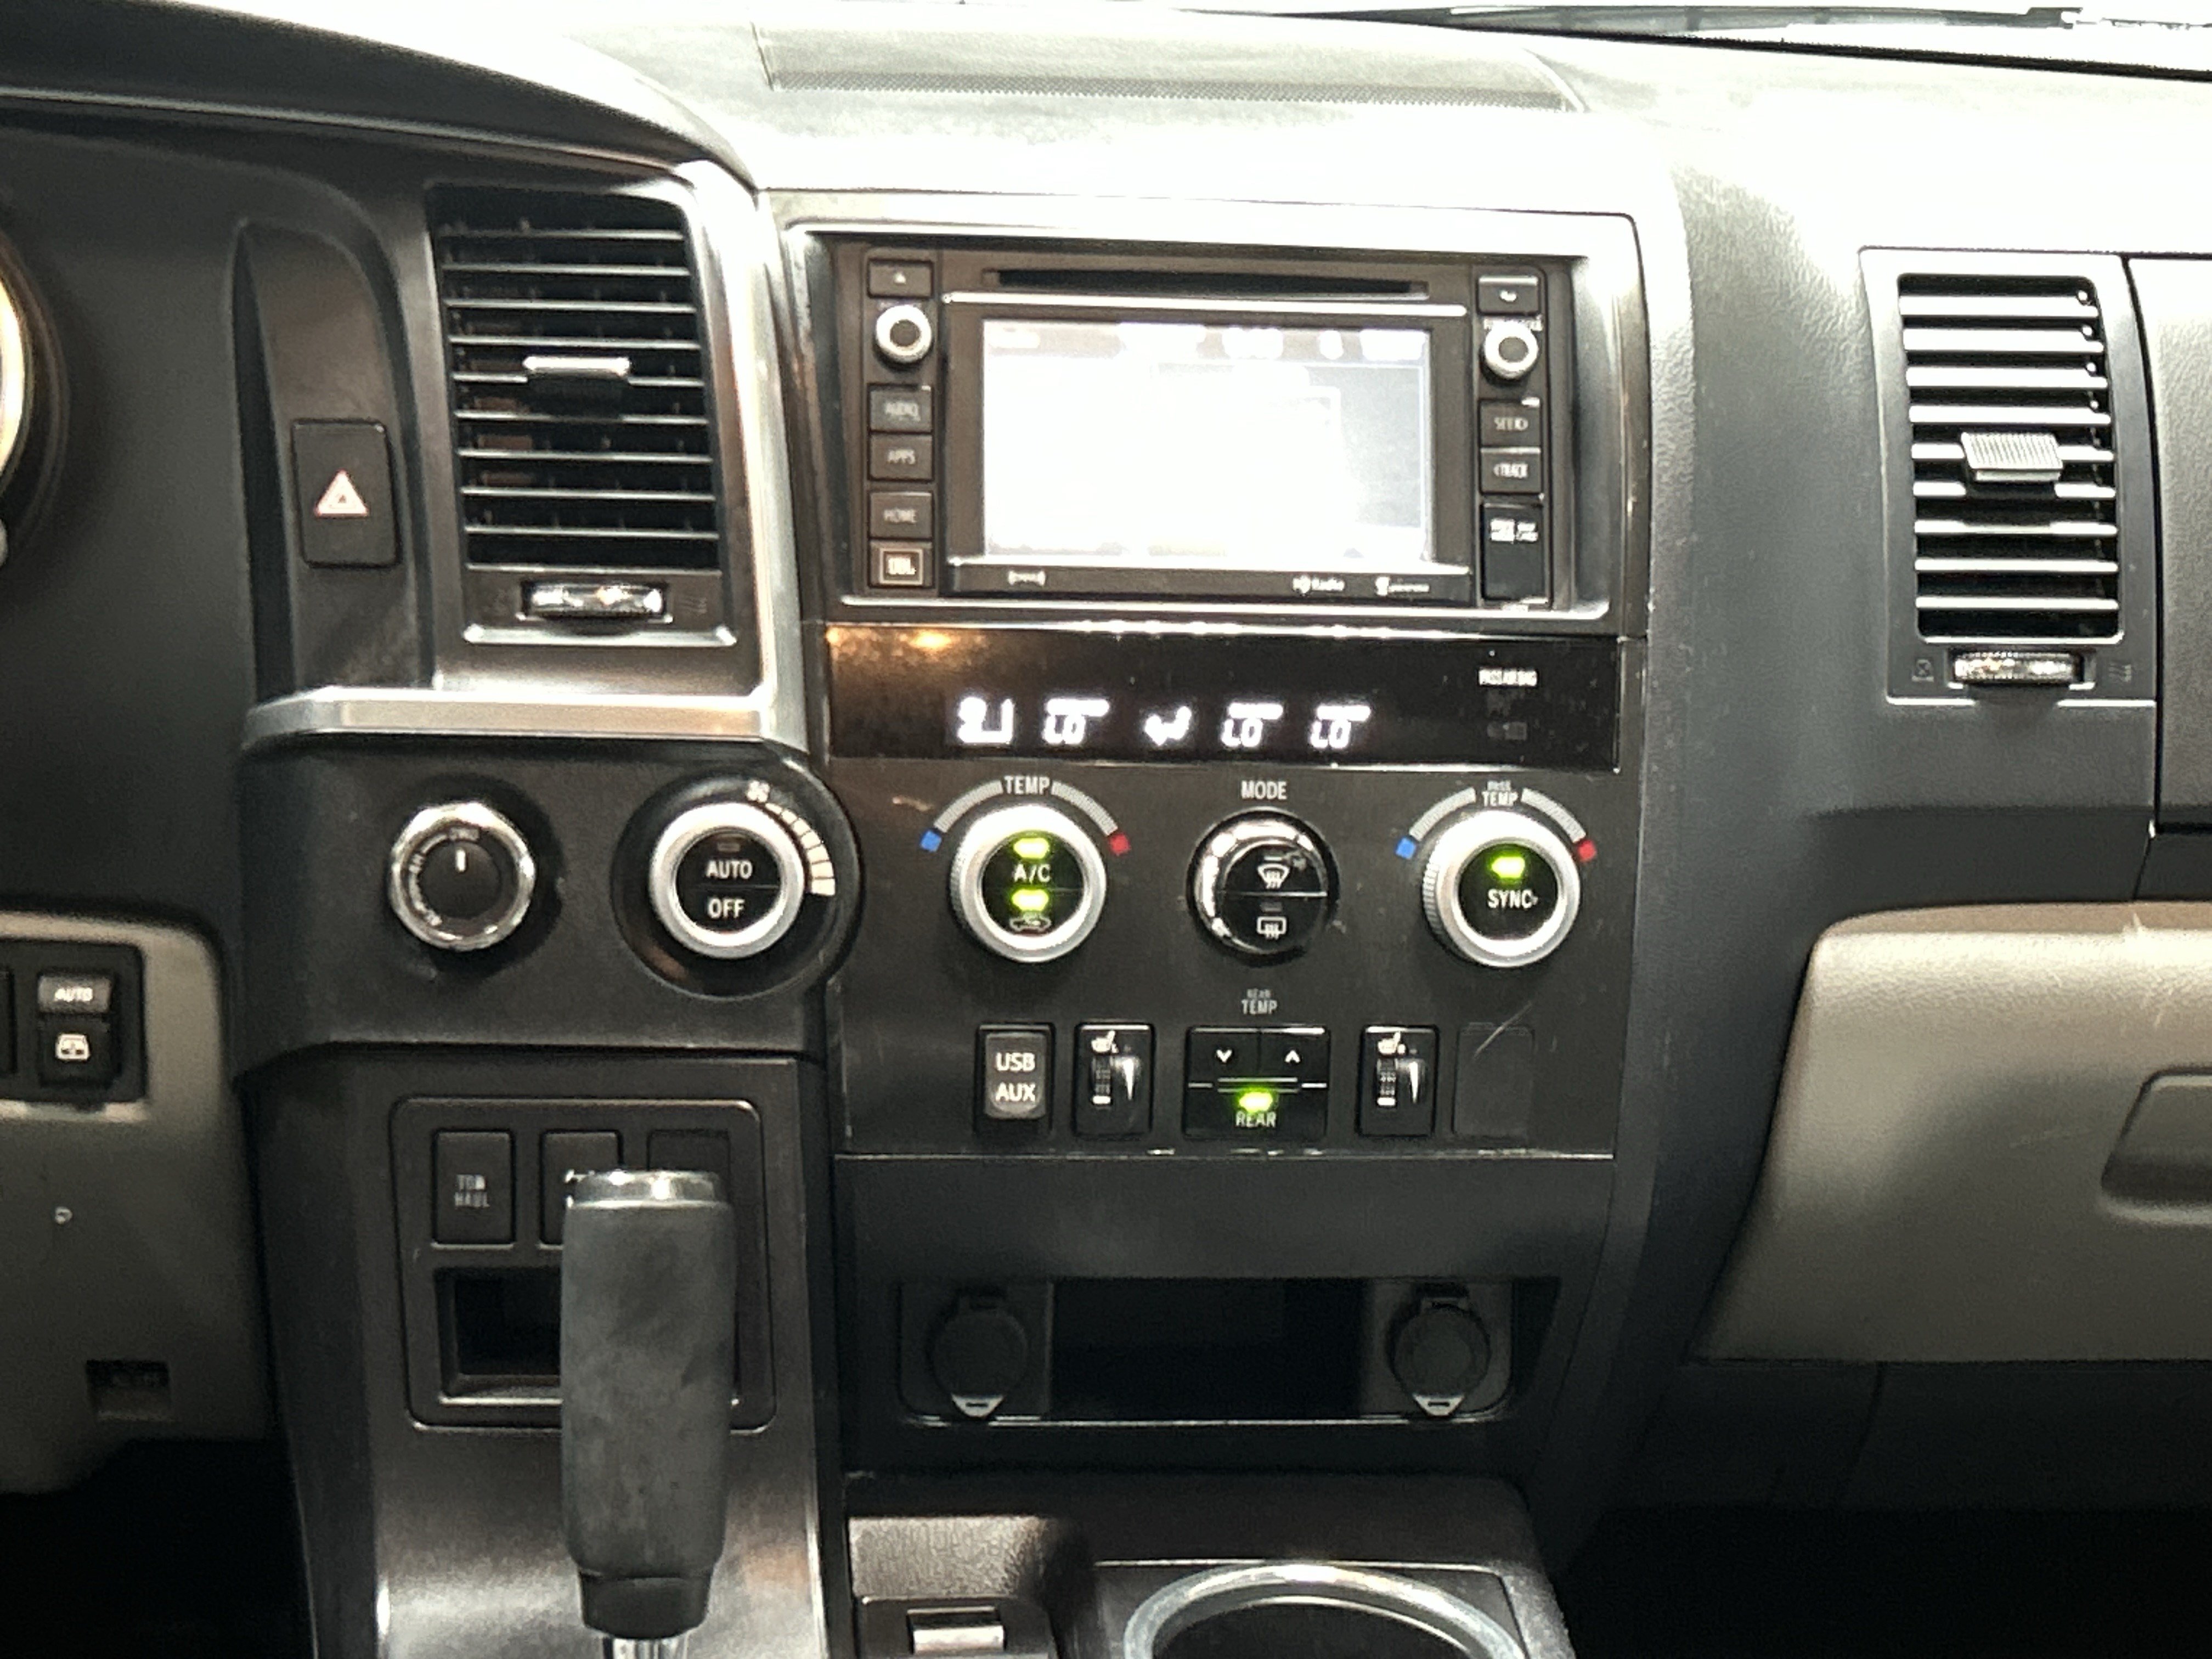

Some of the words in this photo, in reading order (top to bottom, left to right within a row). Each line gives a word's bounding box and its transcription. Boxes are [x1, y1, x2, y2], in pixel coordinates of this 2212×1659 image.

[1004, 776, 1050, 795] TEMP
[1241, 781, 1287, 800] MODE
[1482, 791, 1518, 807] TEMP
[706, 859, 753, 879] AUTO
[1013, 862, 1051, 884] A/C
[708, 898, 744, 919] OFF
[1487, 889, 1533, 910] SYNC
[54, 986, 93, 1002] AUTO
[1240, 998, 1278, 1015] TEMP
[995, 1052, 1035, 1072] USB
[995, 1083, 1036, 1103] AUX
[1235, 1111, 1276, 1128] REAR
